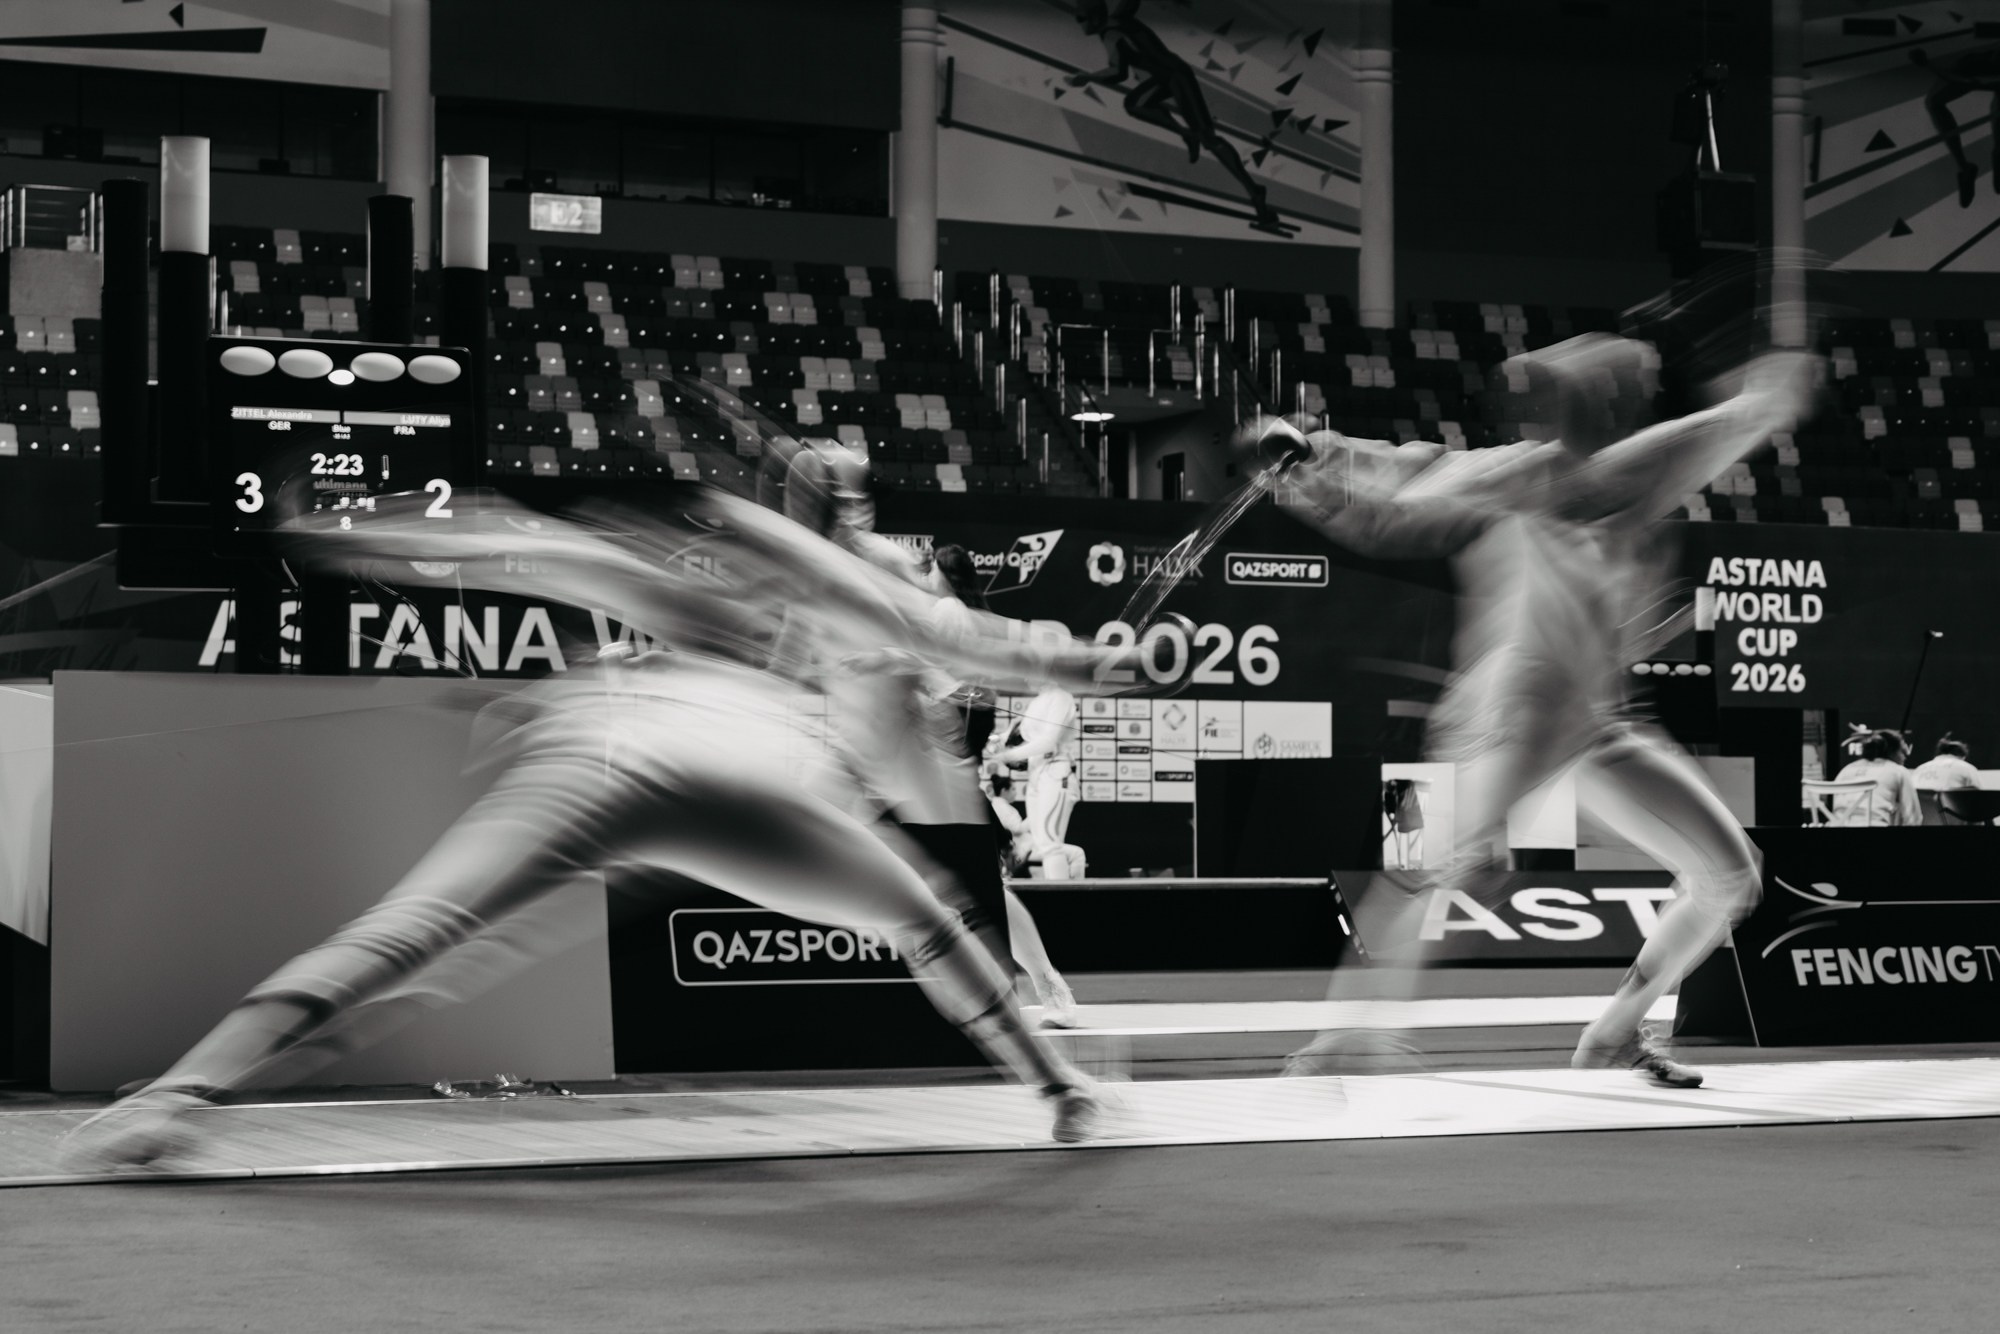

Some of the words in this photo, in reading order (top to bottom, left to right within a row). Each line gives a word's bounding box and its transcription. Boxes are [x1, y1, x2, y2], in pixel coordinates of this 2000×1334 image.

[268, 420, 291, 431] GER
[393, 425, 416, 435] FRA
[310, 452, 364, 476] 2:23
[235, 472, 264, 513] 3
[313, 478, 367, 490] uhlmann
[424, 478, 453, 518] 2
[340, 516, 352, 530] 8
[1232, 561, 1308, 578] QAZSPORT
[1706, 557, 1827, 588] ASTANA
[1714, 592, 1823, 623] WORLD
[1093, 620, 1280, 686] 2026
[1738, 628, 1797, 657] CUP
[1730, 662, 1806, 693] 2026
